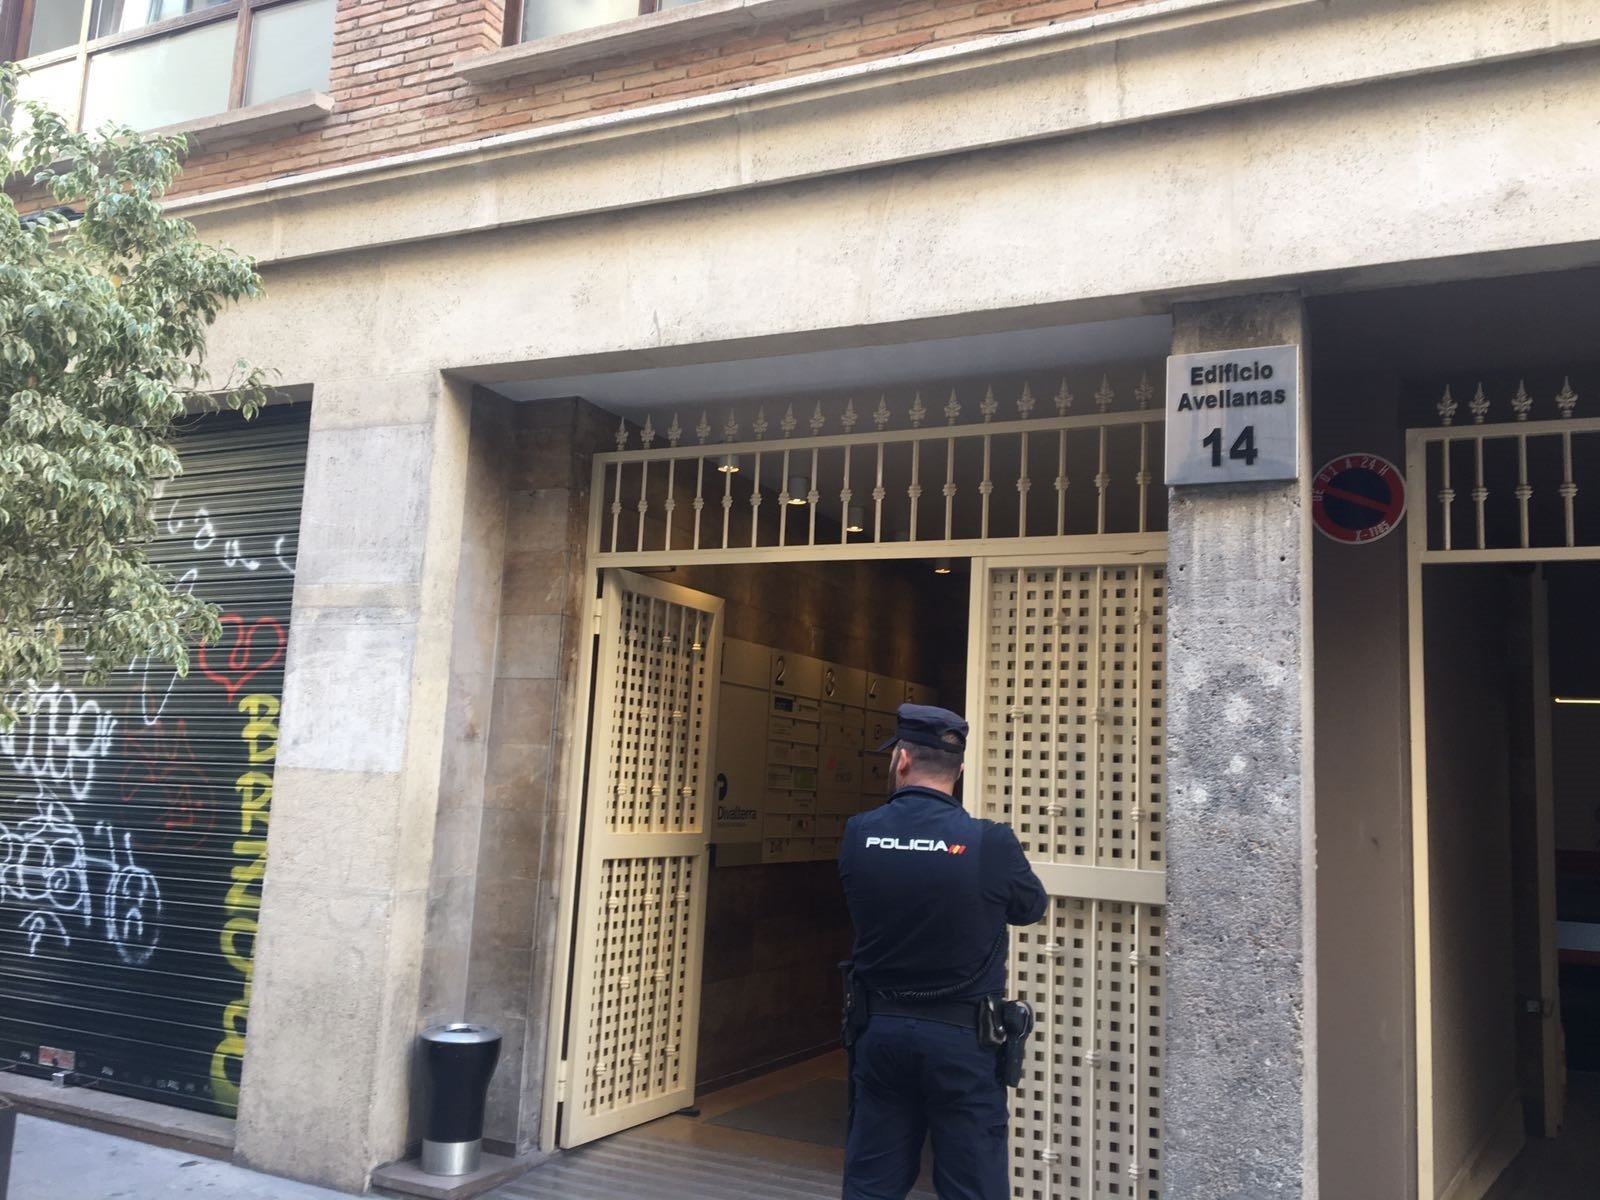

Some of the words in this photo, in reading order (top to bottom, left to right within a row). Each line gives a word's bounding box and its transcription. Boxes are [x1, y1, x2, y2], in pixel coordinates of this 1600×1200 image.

[1190, 361, 1274, 386] Edificio
[1177, 388, 1286, 412] Avellanas
[1202, 425, 1258, 467] 14
[775, 655, 786, 687] 2
[865, 836, 949, 852] POLICIA
